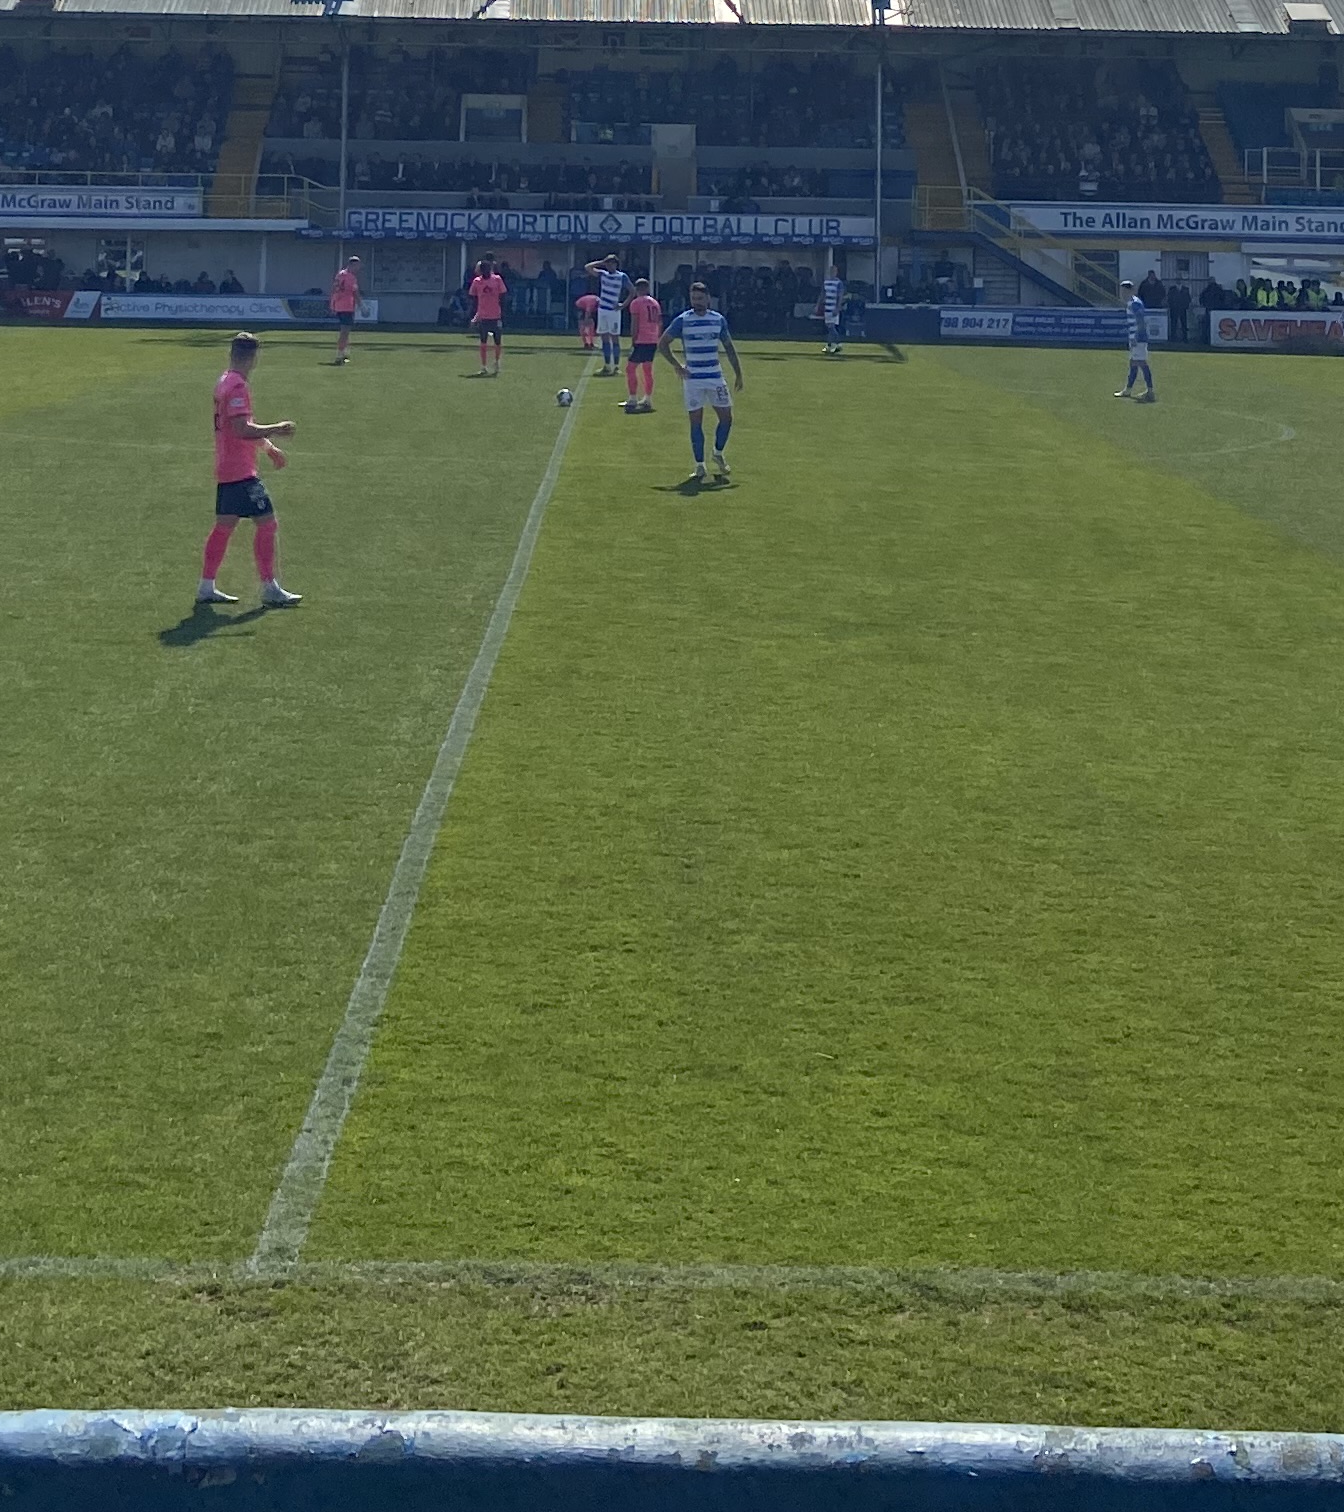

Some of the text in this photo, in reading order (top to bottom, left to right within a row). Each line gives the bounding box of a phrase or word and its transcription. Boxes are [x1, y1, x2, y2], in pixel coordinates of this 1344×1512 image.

[1, 194, 72, 210] McGraw
[77, 194, 119, 210] Main
[124, 195, 175, 211] Stand
[346, 211, 842, 236] GREENOCK MORTON FOOTBALL CLUB
[1059, 212, 1096, 228] The
[1101, 213, 1151, 229] Allan
[1157, 214, 1236, 230] McGraw
[1240, 215, 1289, 231] Main
[154, 302, 245, 316] Physiotherapy
[986, 318, 1009, 329] 217
